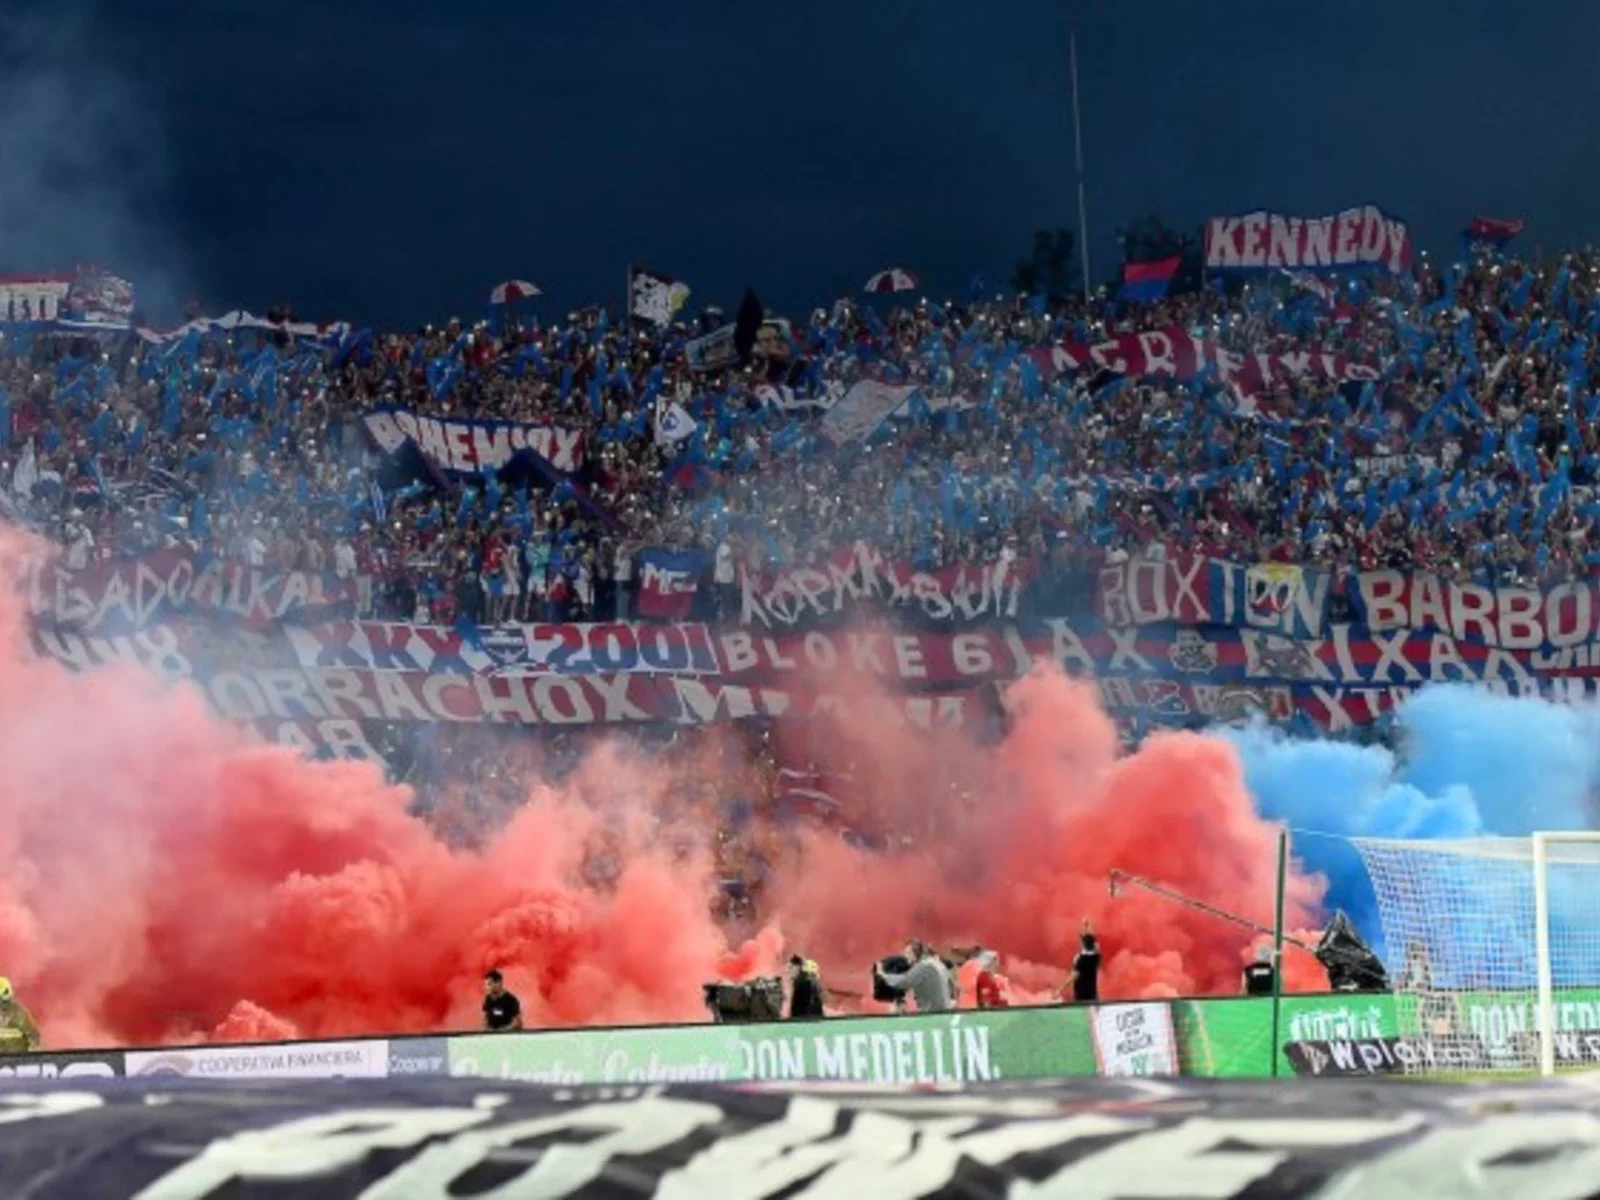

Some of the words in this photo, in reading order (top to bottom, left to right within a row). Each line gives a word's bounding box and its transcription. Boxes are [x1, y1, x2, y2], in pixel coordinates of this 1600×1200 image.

[1207, 205, 1405, 273] KENNEDY
[1360, 569, 1600, 649] BARBO
[533, 622, 718, 674] 2001
[722, 630, 926, 677] BLOKE
[198, 1054, 285, 1074] COOPERATIVA
[287, 1048, 363, 1069] FINANCIERA
